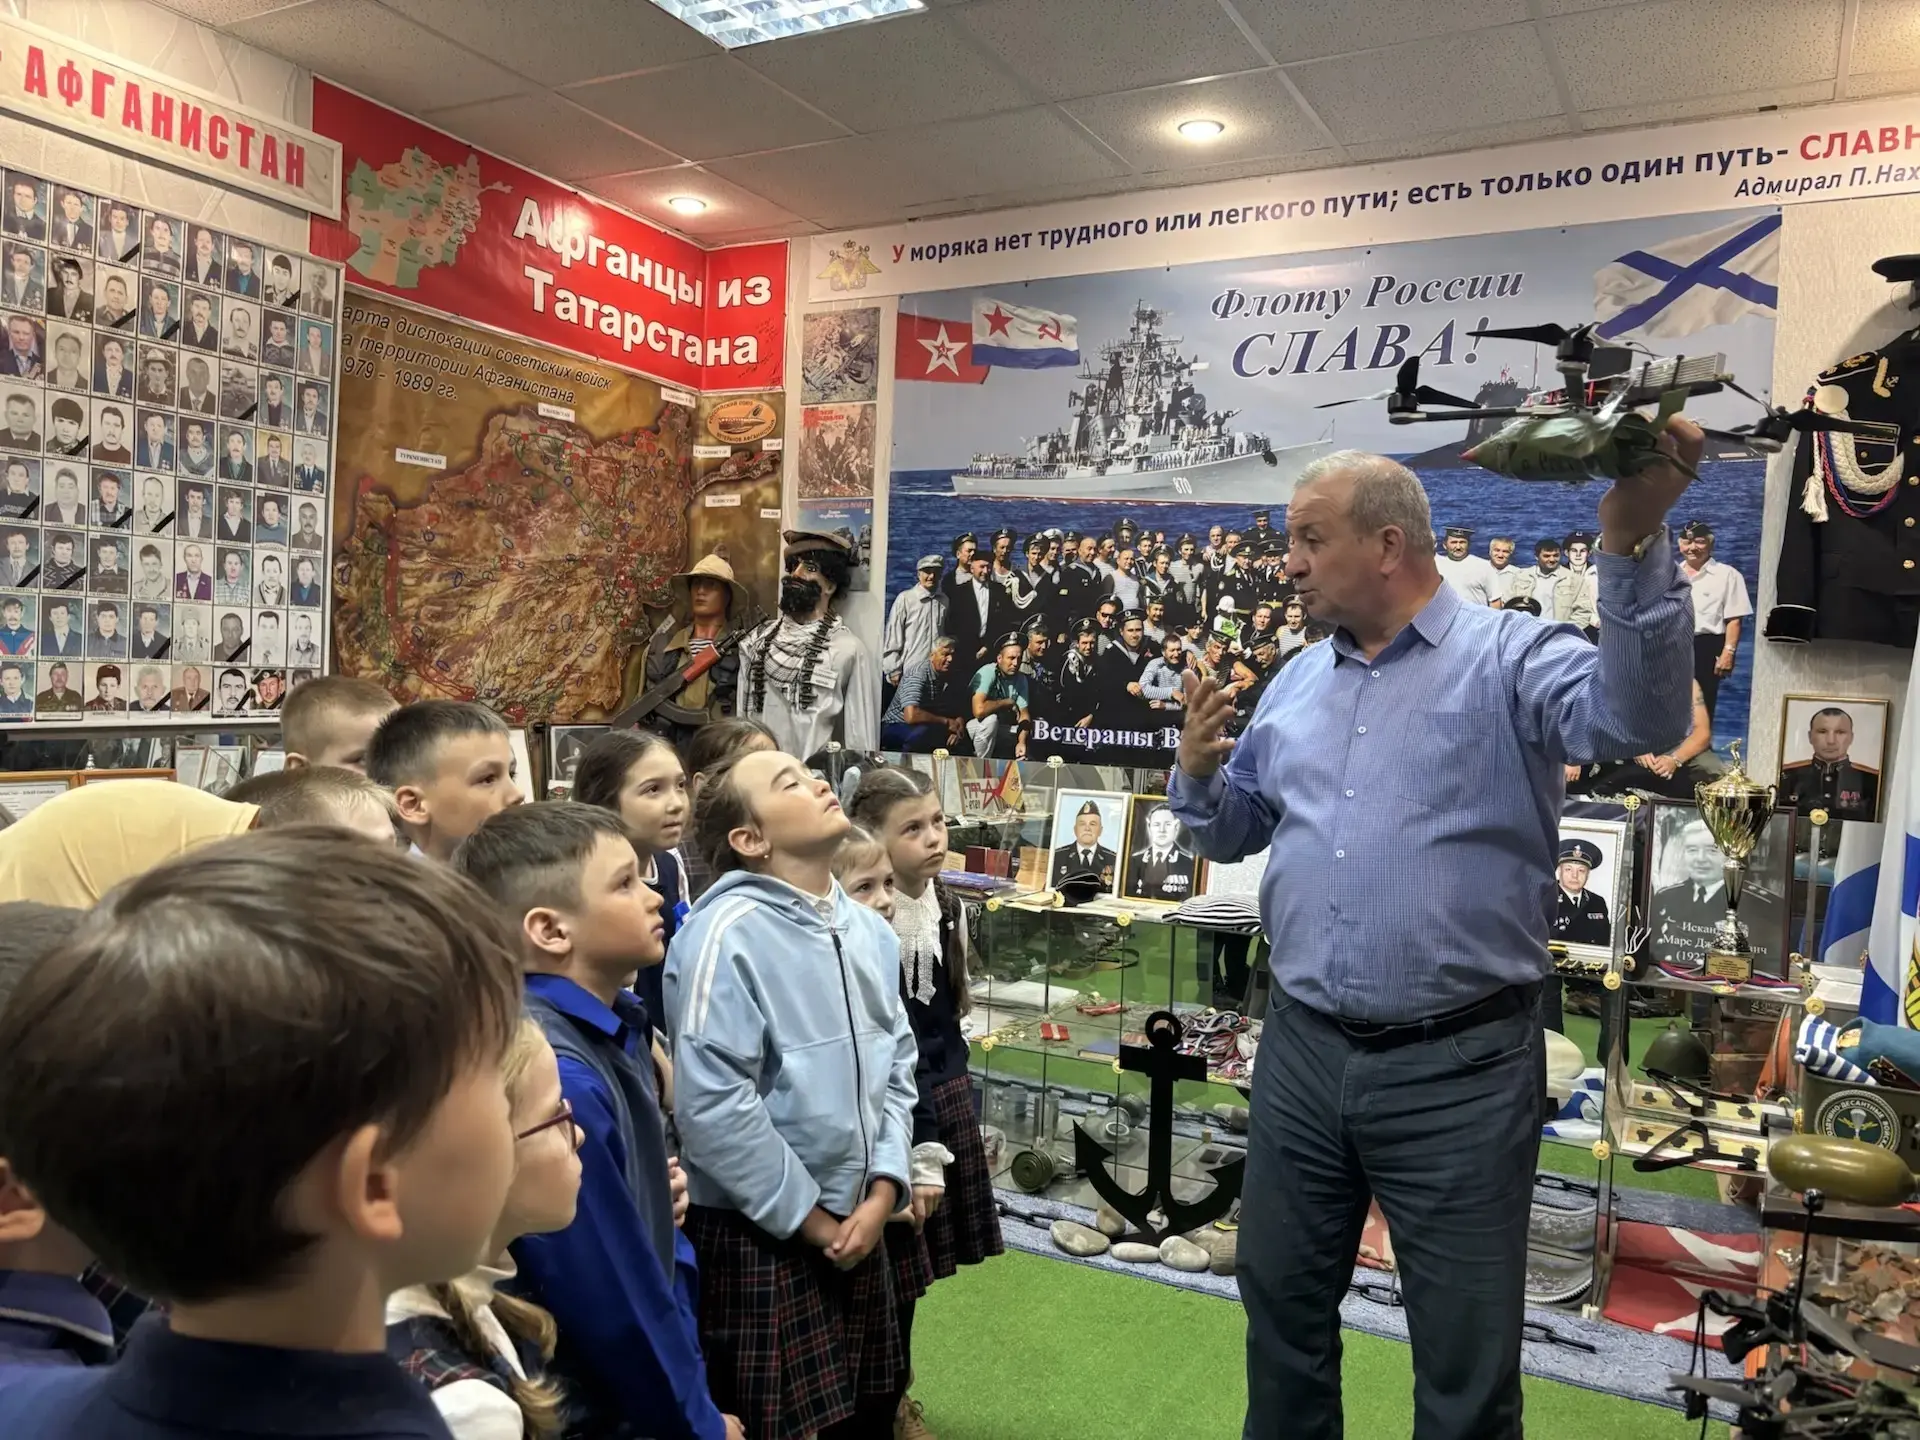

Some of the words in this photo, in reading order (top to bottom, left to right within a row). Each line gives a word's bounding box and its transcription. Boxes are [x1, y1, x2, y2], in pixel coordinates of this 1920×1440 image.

[24, 45, 305, 188] АФГАНИСТАН
[892, 244, 905, 263] У
[910, 237, 988, 263] моряка
[995, 232, 1032, 251] нет
[1038, 218, 1148, 249] трудного
[1156, 212, 1201, 233] или
[1208, 199, 1315, 227] легкого
[1323, 188, 1398, 218] пути;
[1408, 181, 1473, 204] есть
[1481, 166, 1592, 196] только
[1601, 155, 1684, 184] один
[1695, 147, 1789, 176] путь-
[1734, 173, 1842, 198] Адмирал
[513, 197, 703, 308] Афганцы
[717, 275, 772, 309] из
[524, 264, 758, 367] Татарстана
[1211, 285, 1351, 320] Флоту
[1362, 271, 1525, 308] России
[342, 306, 391, 329] арта
[396, 316, 492, 357] дислокации
[495, 348, 572, 379] советских
[575, 371, 612, 391] войск
[359, 337, 470, 377] территории
[473, 364, 577, 405] Афганистана.
[1231, 316, 1490, 378] СЛАВА!
[341, 355, 375, 379] 979
[394, 369, 434, 393] 1989
[437, 383, 457, 400] гг.
[1172, 476, 1193, 495] 870
[1032, 718, 1154, 749] Ветераны
[1163, 726, 1184, 749] В
[1663, 934, 1693, 947] Марс
[1682, 921, 1719, 936] Искан
[1825, 1100, 1885, 1136] ОЗДУШНО-ДЕСАНТНЫЕ
